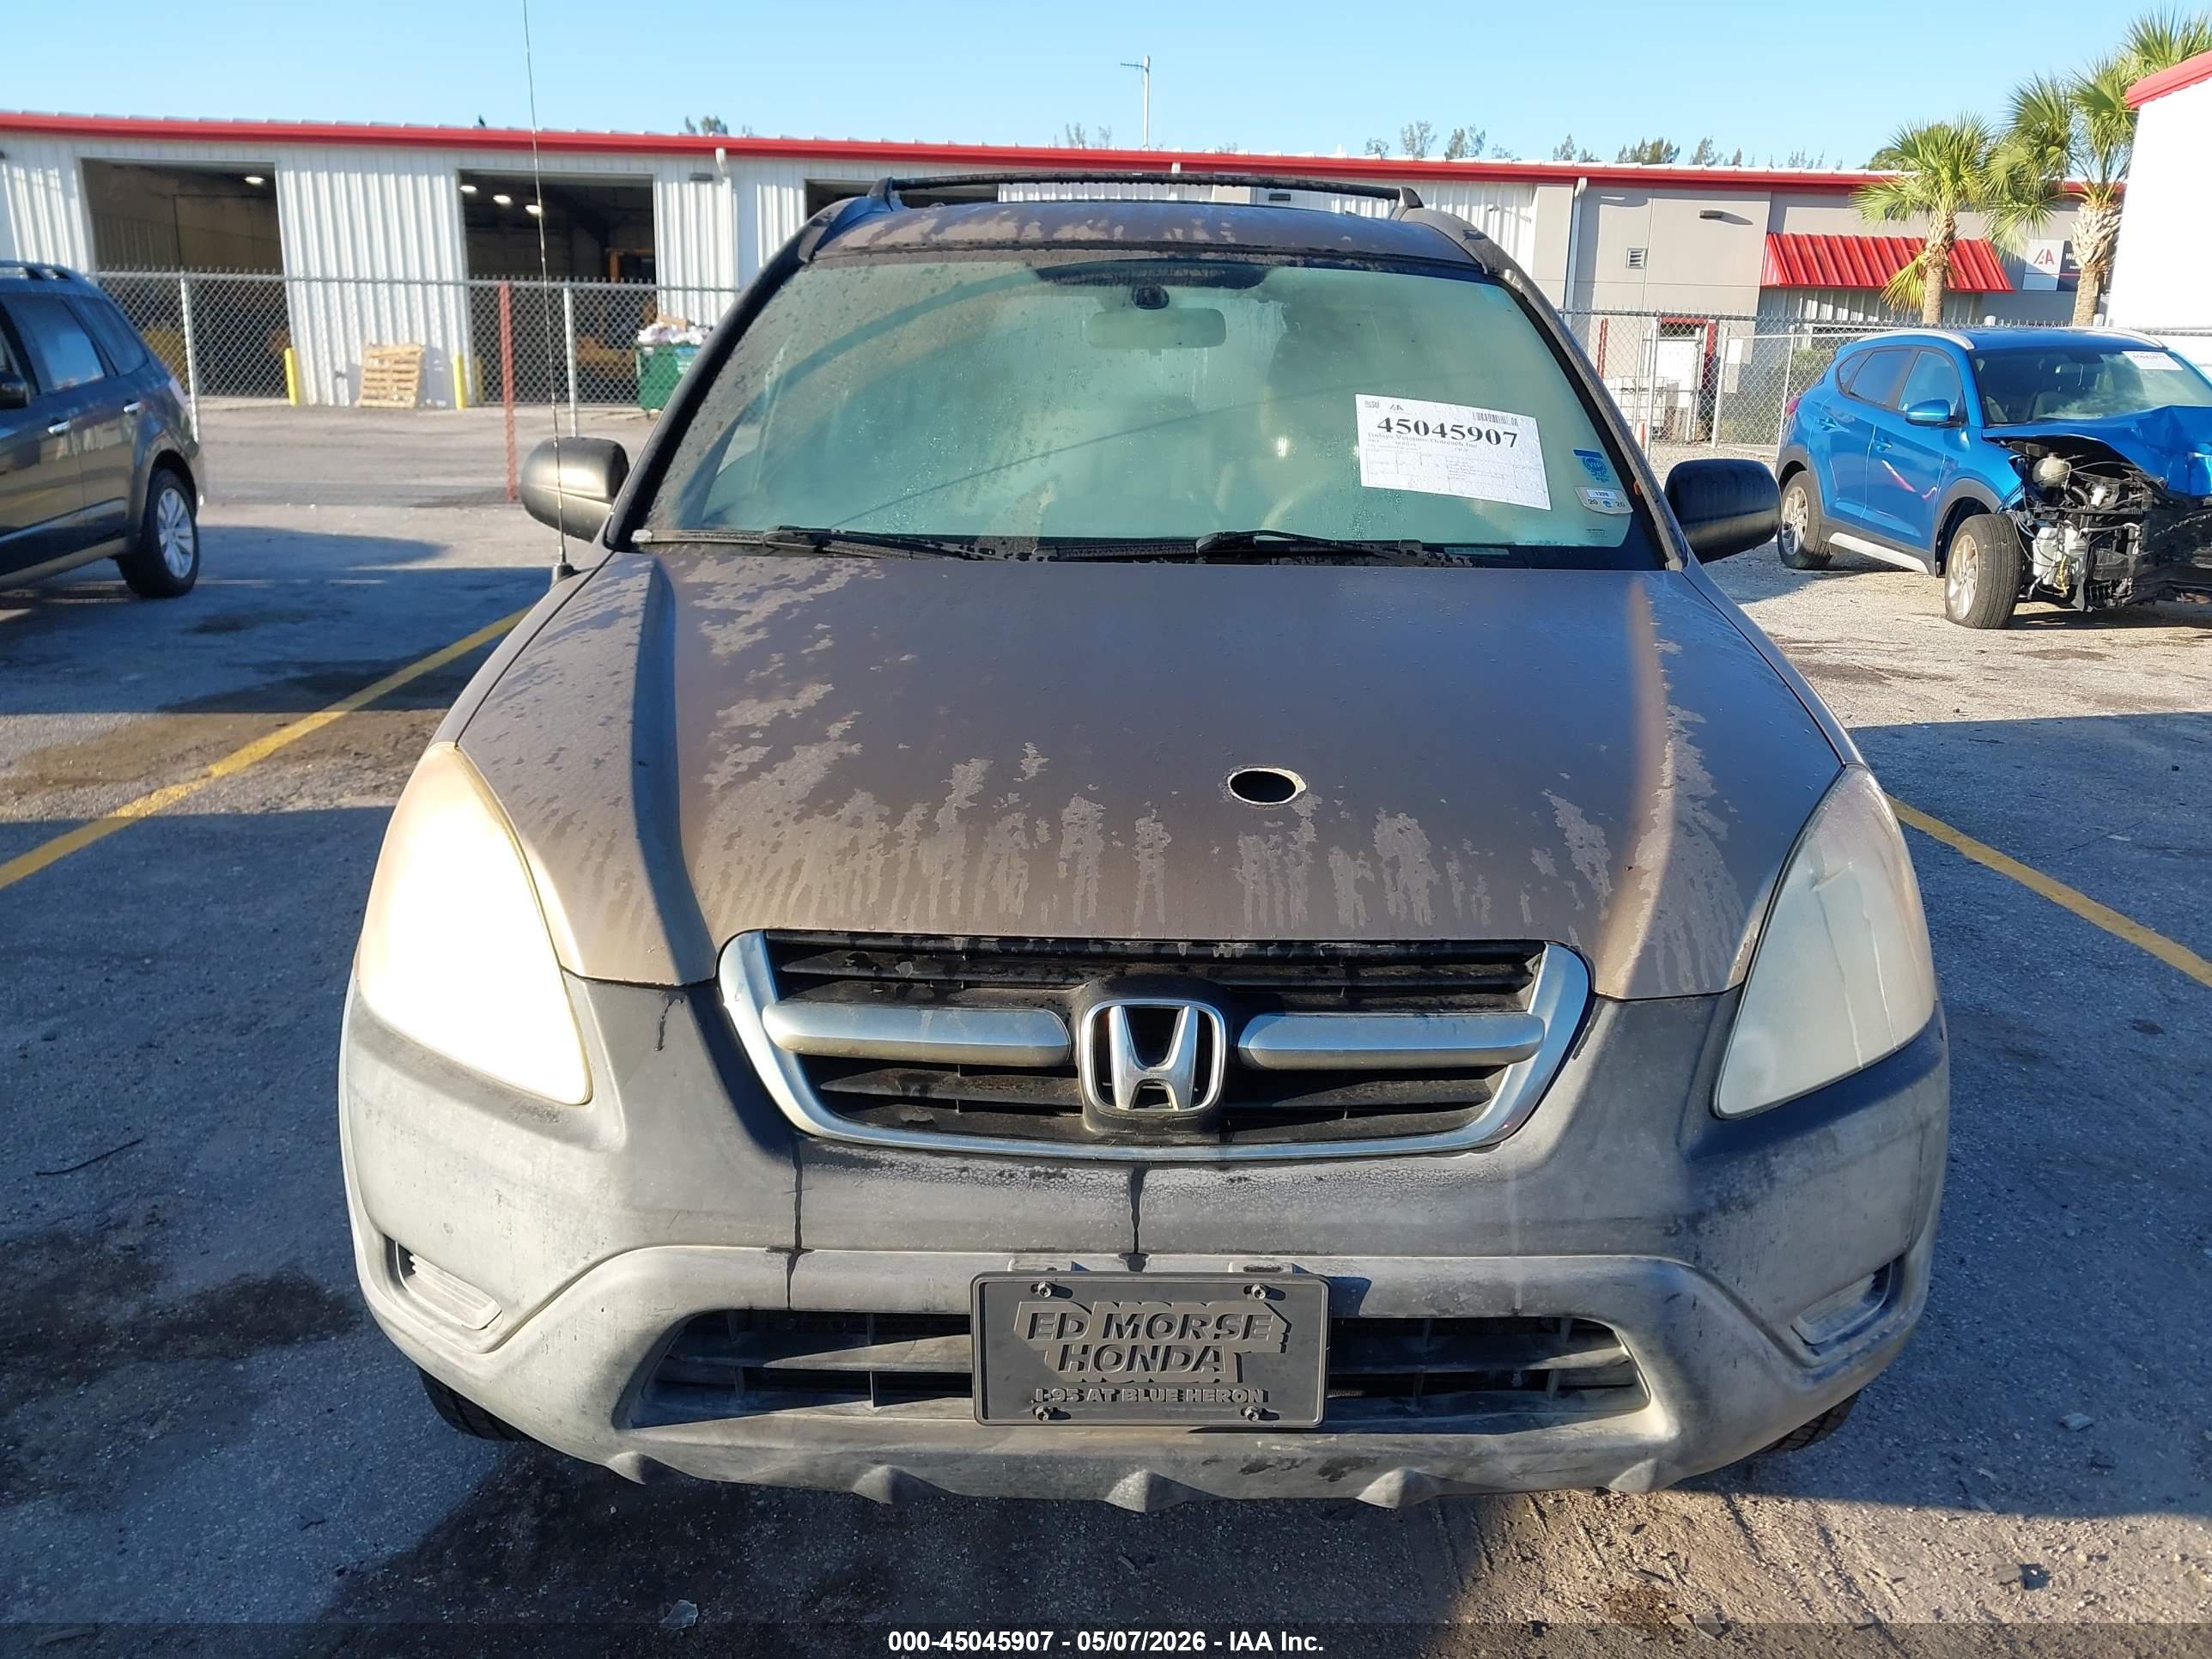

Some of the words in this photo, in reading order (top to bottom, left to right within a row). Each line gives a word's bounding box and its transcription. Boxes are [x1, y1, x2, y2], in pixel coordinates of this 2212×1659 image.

[1377, 416, 1518, 448] 45045907
[1028, 1312, 1091, 1340] ED
[1103, 1311, 1274, 1340] MORSE
[1058, 1344, 1227, 1374] HONDA
[1036, 1389, 1082, 1402] I-95
[1086, 1389, 1117, 1402] AT
[1121, 1389, 1181, 1402] BLUE
[1186, 1389, 1266, 1403] HERON
